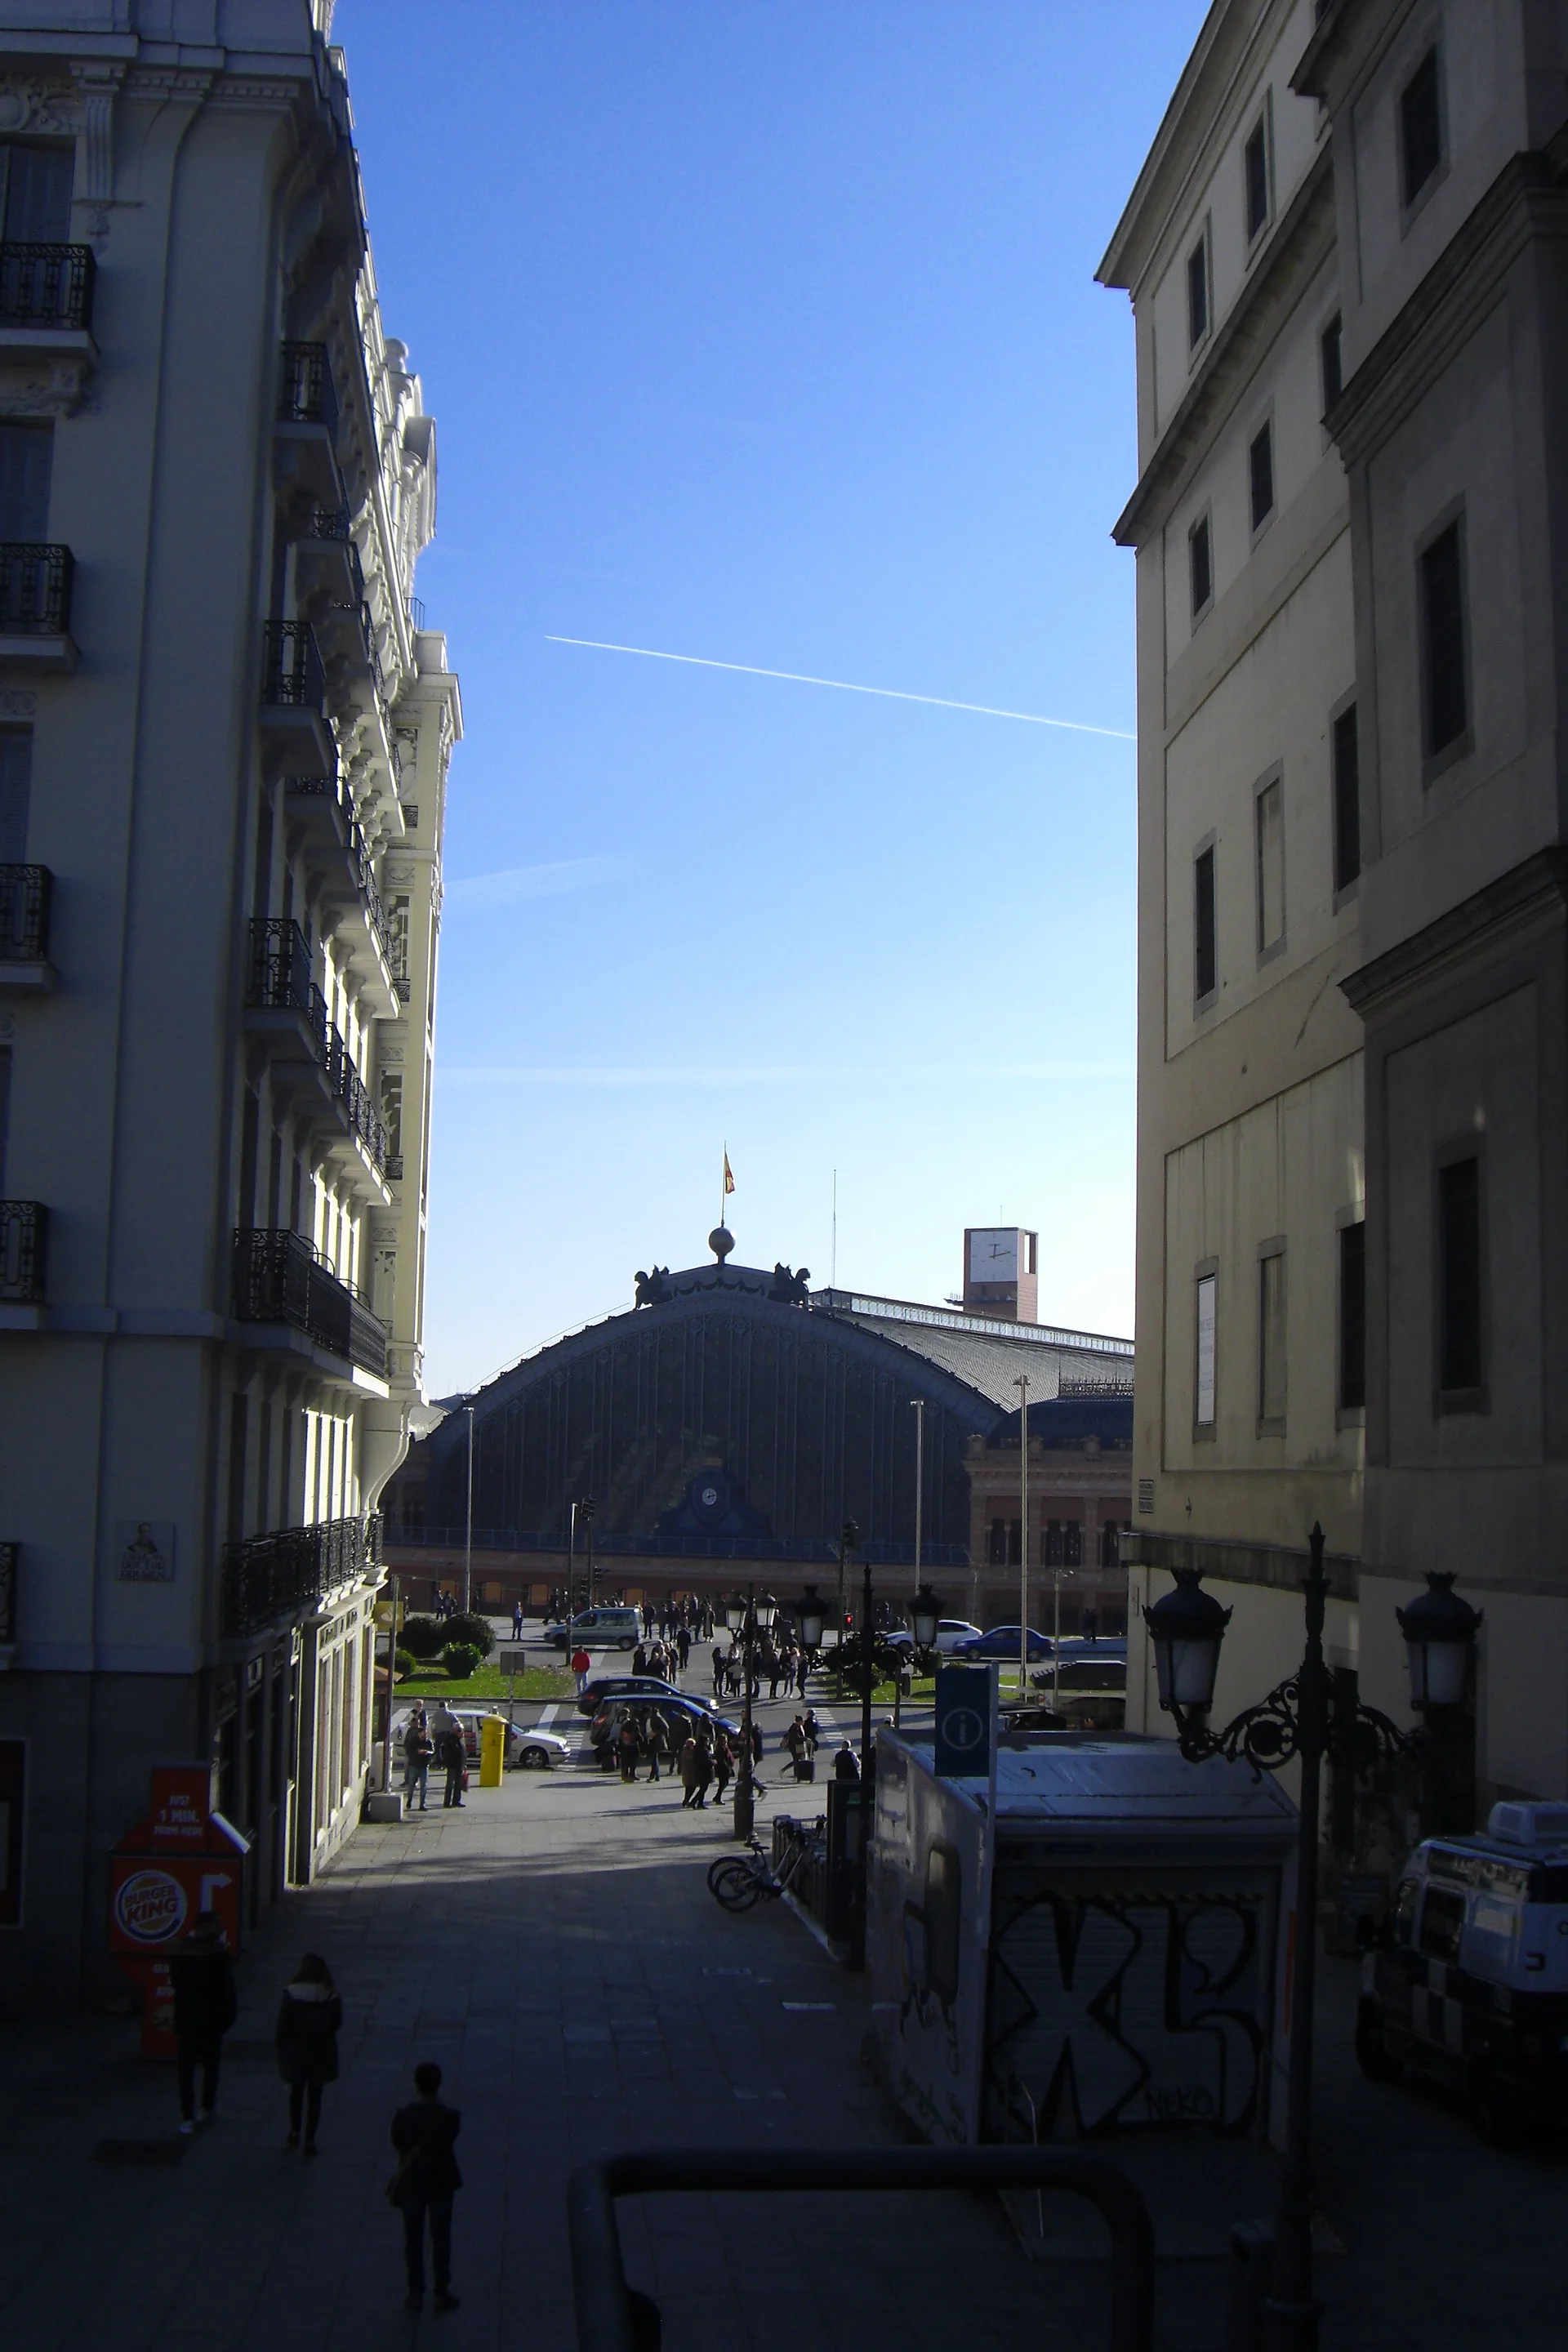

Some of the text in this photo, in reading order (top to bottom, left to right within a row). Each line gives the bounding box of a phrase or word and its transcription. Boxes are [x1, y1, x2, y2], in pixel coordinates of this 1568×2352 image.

[121, 1561, 166, 1570] DOCTOR
[169, 1795, 190, 1806] JUST
[159, 1810, 200, 1823] 1 MIN.
[154, 1826, 179, 1836] FROM
[125, 1885, 176, 1909] BURGER
[127, 1896, 179, 1923] KING
[1146, 2086, 1214, 2119] NEKO
